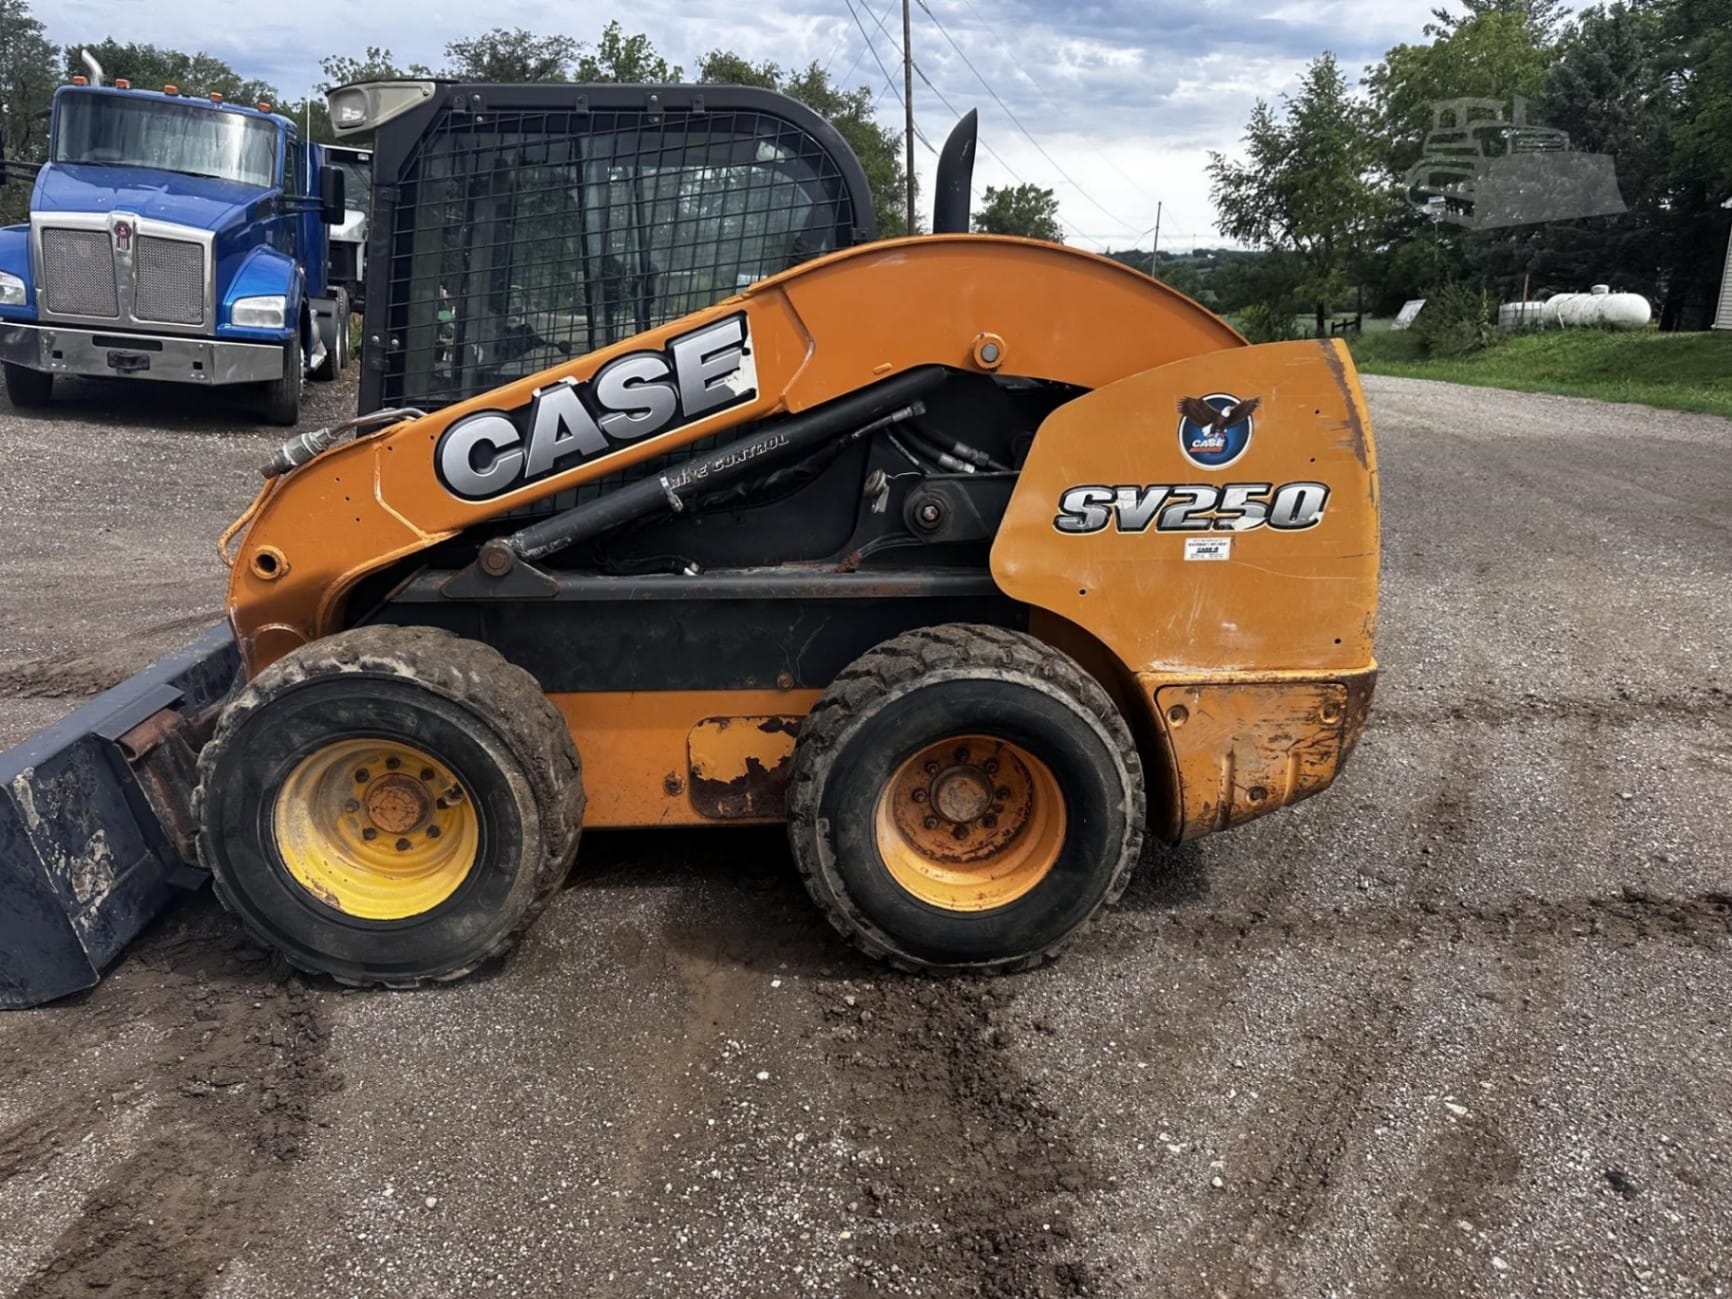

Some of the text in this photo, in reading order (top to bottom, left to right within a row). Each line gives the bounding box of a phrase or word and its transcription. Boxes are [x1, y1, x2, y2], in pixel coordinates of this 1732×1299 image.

[439, 317, 750, 497] CASE
[713, 433, 790, 473] CONTROL
[1191, 438, 1225, 448] CASE
[1054, 482, 1330, 532] SV250
